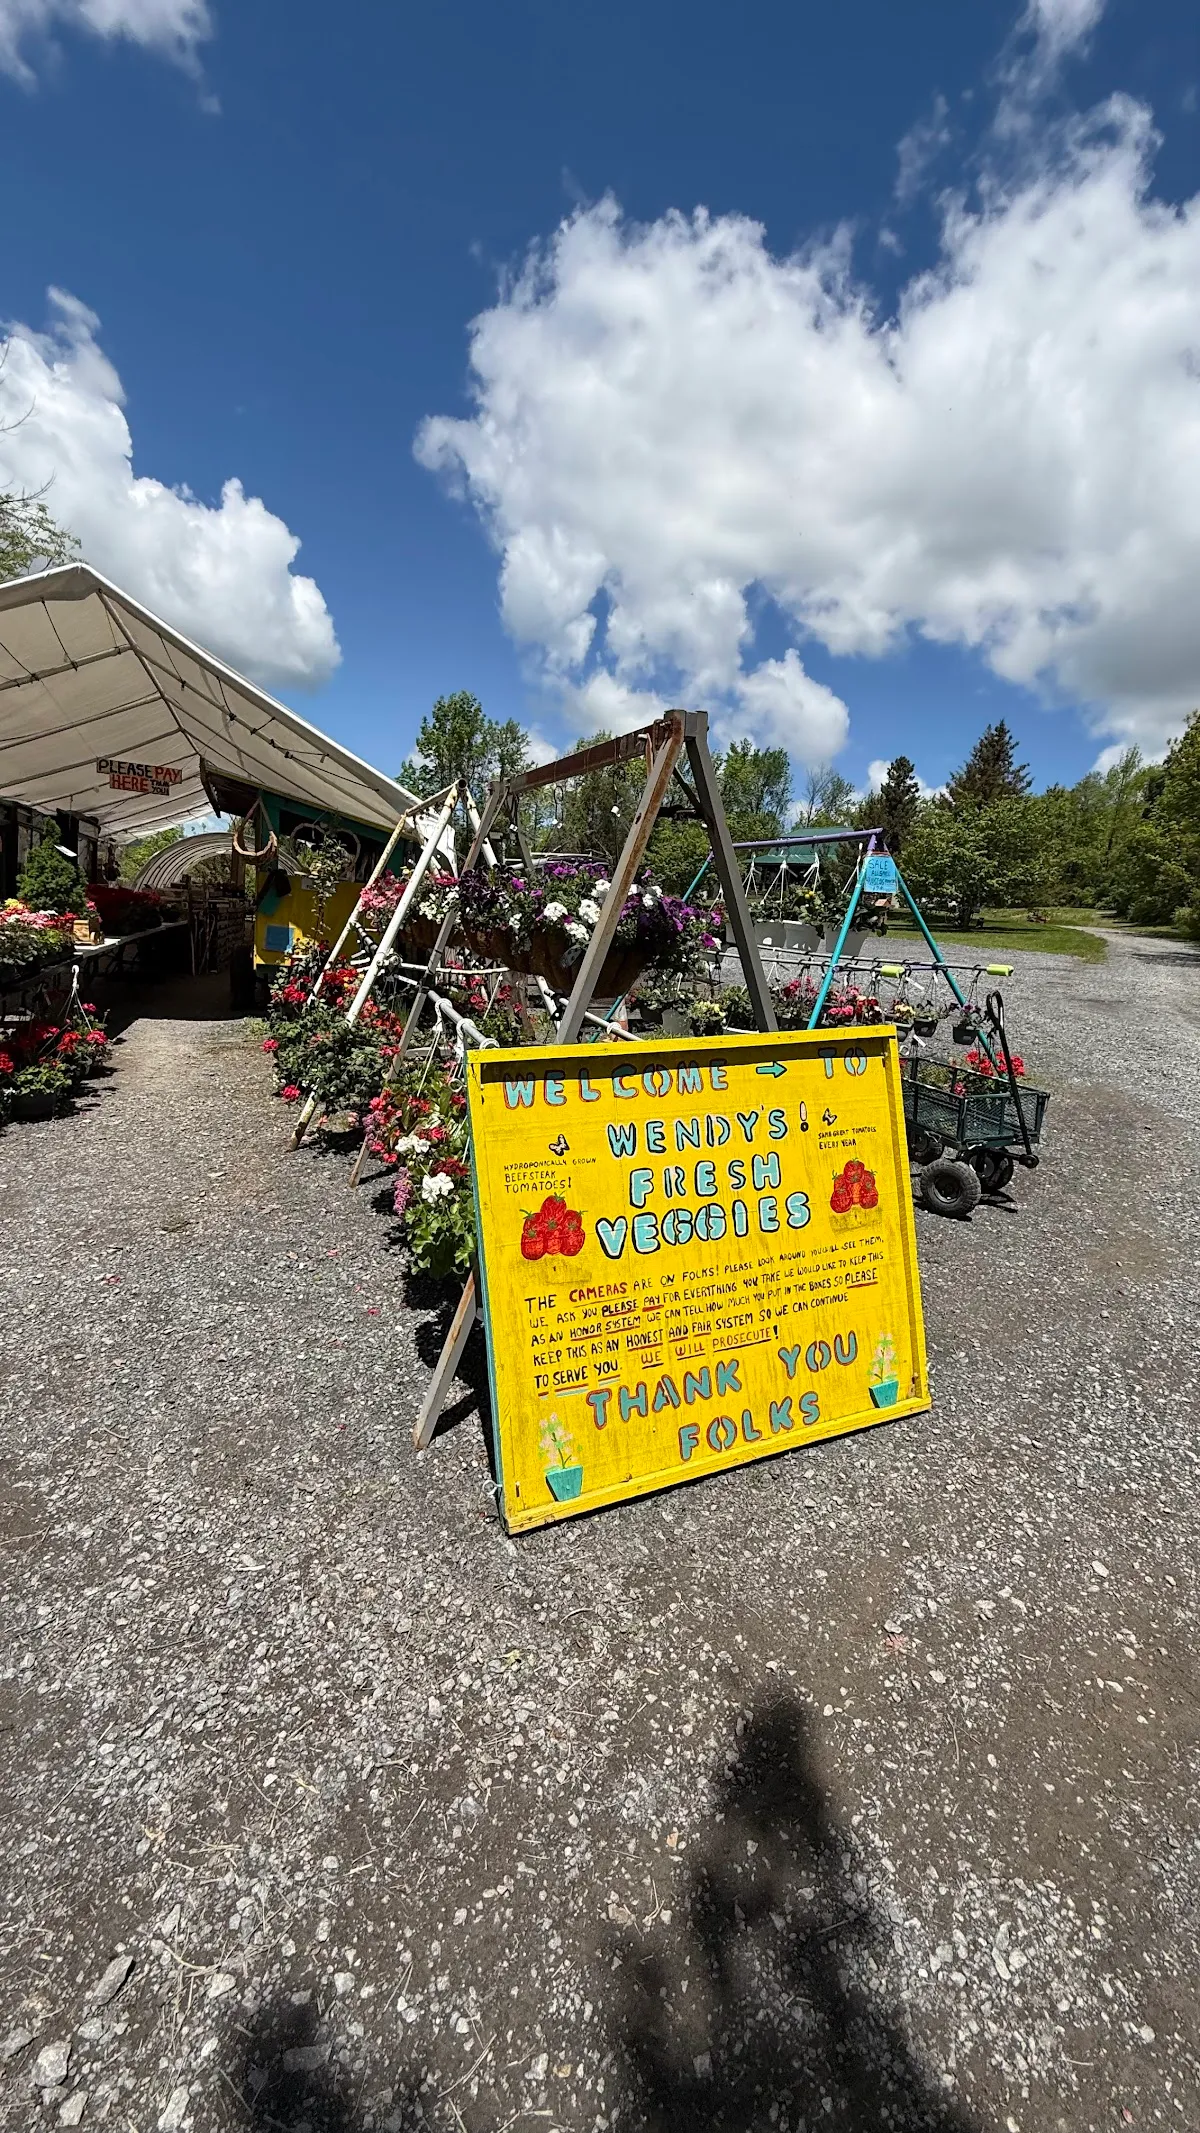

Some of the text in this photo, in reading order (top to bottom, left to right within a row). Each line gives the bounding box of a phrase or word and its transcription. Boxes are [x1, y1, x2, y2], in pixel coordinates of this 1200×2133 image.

[98, 759, 180, 784] PLEASE PAY
[112, 774, 149, 792] HERE
[868, 859, 888, 870] SALE
[503, 1047, 867, 1110] WELCOME TO
[504, 1159, 567, 1171] HYDROPONICALLY
[841, 1138, 856, 1147] YEAR
[504, 1176, 571, 1194] TOMATOES!
[505, 1170, 556, 1183] BEEFSTEAK
[629, 1151, 781, 1209] FRESH
[595, 1192, 811, 1259] VEGGIES
[525, 1294, 557, 1314] THE
[569, 1282, 628, 1303] CAMERAS
[633, 1277, 653, 1291] ARE
[660, 1274, 675, 1286] ON
[682, 1265, 719, 1282] FOLKS!
[724, 1262, 753, 1274] PLEASE
[758, 1256, 775, 1267] LOOK
[779, 1250, 806, 1261] AROUND
[842, 1241, 856, 1250] SEE
[530, 1251, 884, 1329] WE ASK YOU PLEASE PAY FOR EVERYTHING YOU TAKE WE WOULD LIKE TO KEEP THIS
[531, 1267, 878, 1348] AS AN HONOR SYSTEM WE CAN TELL HOW MUCH YOU PUT IN THE BOXES SO PLEASE
[533, 1292, 849, 1367] KEEP THIS AS AN HONEST AND FAIR SYSTEM SO WE CAN CONTINUE
[534, 1373, 549, 1389] TO
[552, 1365, 588, 1386] SERVE
[641, 1351, 662, 1364] WE
[675, 1342, 705, 1356] WILL
[586, 1330, 859, 1430] THANK YOU
[678, 1391, 821, 1462] FOLKS
